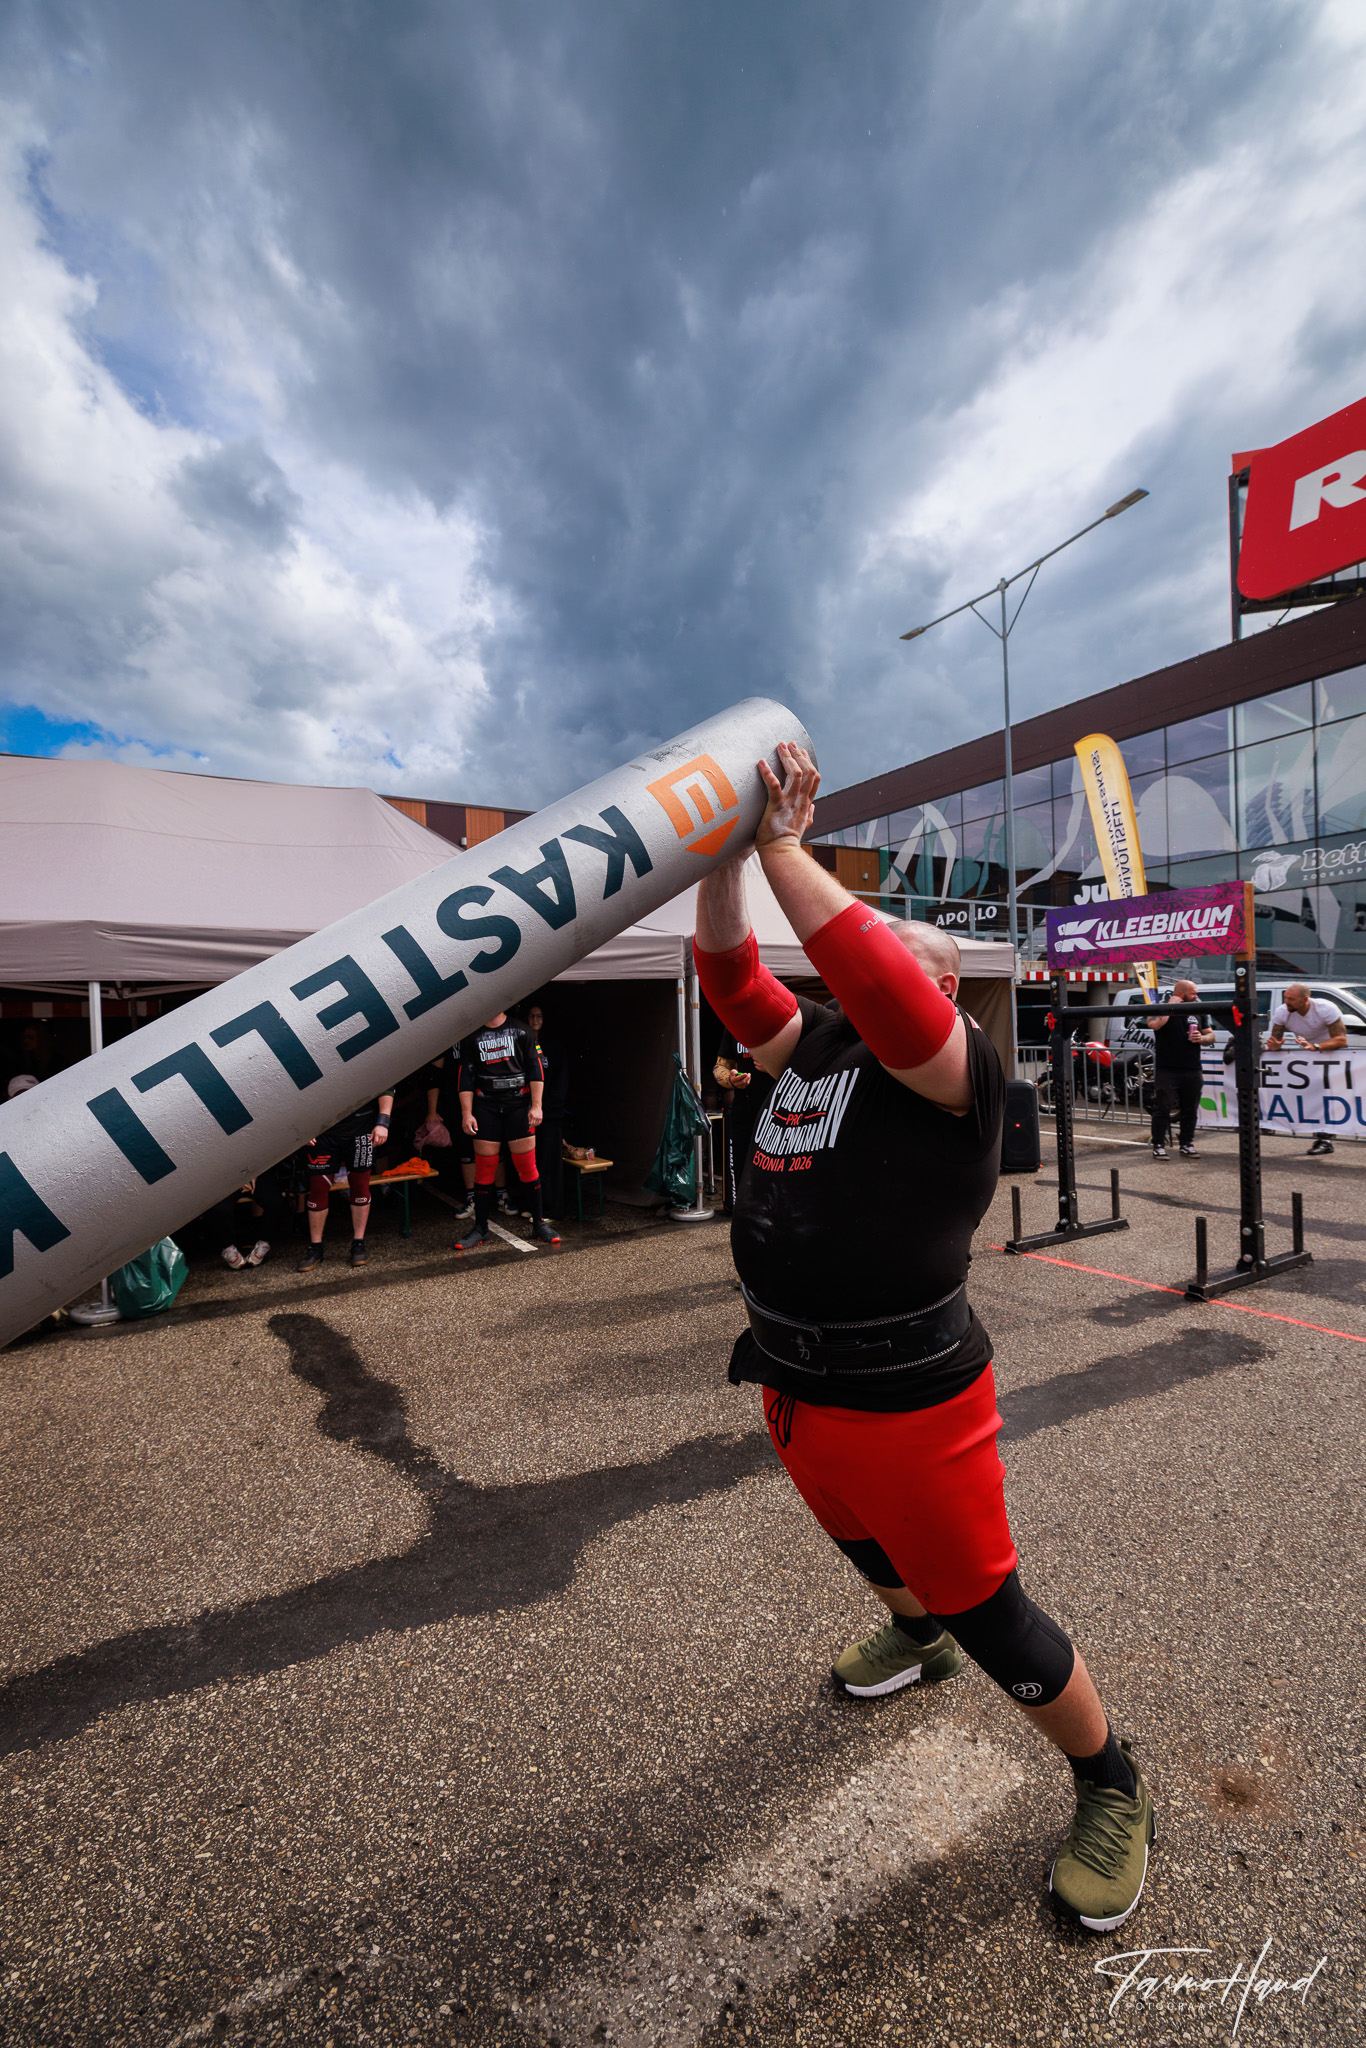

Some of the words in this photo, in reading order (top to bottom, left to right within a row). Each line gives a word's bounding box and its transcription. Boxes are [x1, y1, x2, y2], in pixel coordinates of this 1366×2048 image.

[1302, 867, 1363, 881] ZOOKAUP
[936, 905, 997, 926] APOLO
[1096, 904, 1234, 941] KLEEBIKUM
[1166, 929, 1222, 940] REKLAAM
[87, 805, 653, 1185] KASTELLI
[786, 1113, 803, 1126] PRO
[753, 1150, 785, 1172] ESTONIA
[788, 1156, 813, 1171] 2026
